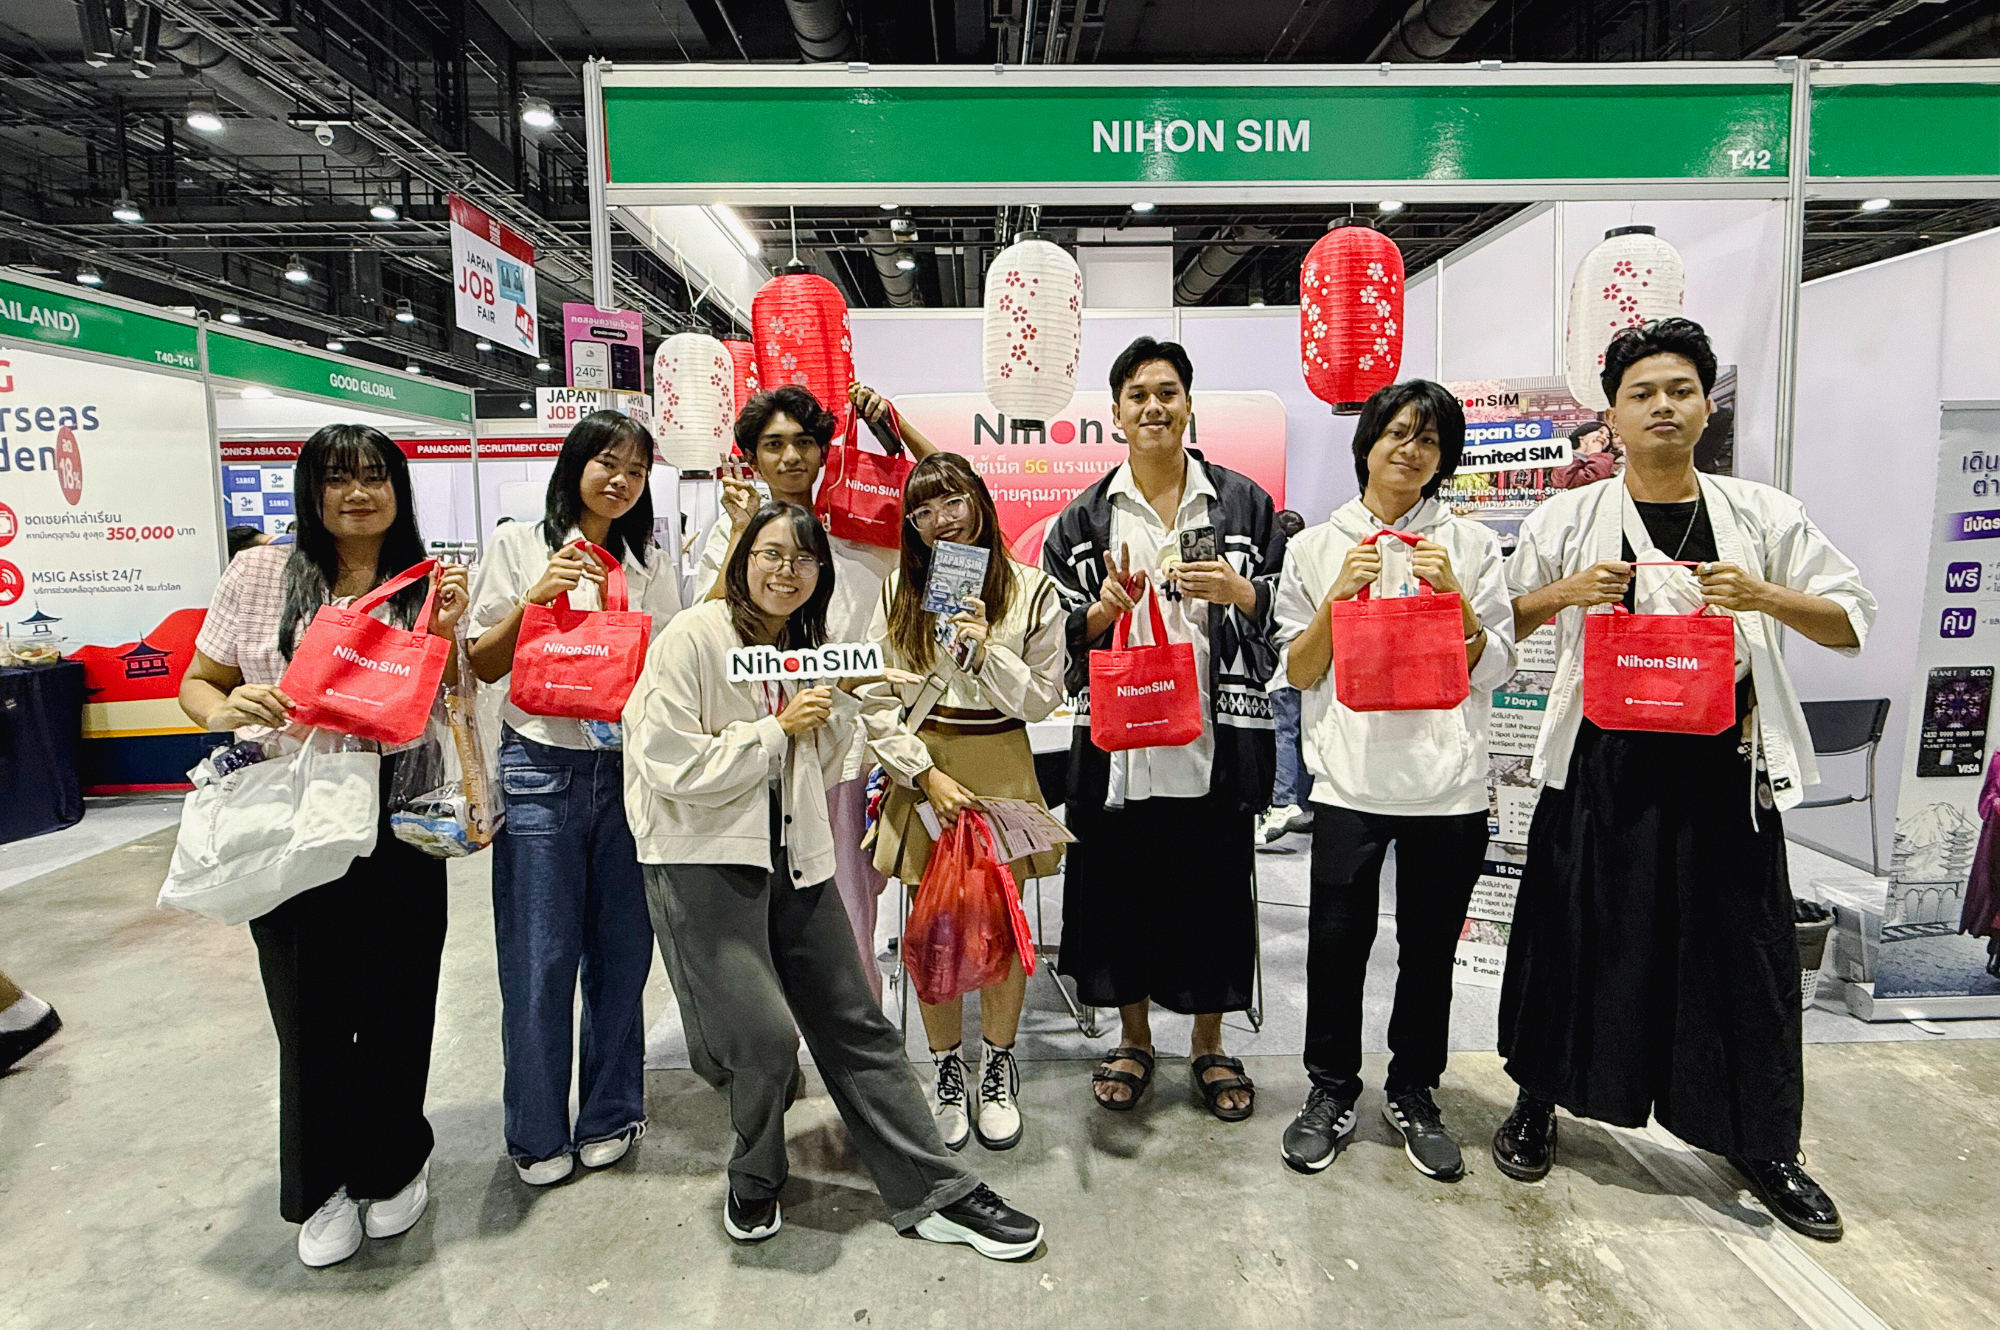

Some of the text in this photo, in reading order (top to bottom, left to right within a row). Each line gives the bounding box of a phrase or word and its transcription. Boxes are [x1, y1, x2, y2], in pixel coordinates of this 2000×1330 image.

[1093, 119, 1311, 153] NIHON SIM
[1728, 149, 1771, 170] T42
[466, 251, 493, 274] JAPAN
[459, 266, 495, 306] JOB
[477, 306, 496, 324] FAIR
[154, 350, 195, 368] T40-T41
[575, 366, 596, 378] 240
[329, 373, 397, 400] GOOD GLOBAL
[547, 389, 597, 403] JAPAN
[547, 405, 577, 420] JOB
[1514, 423, 1541, 438] 5G
[253, 446, 275, 455] ASIA
[417, 444, 471, 454] PANASONIC
[1529, 445, 1563, 461] SIM
[59, 457, 81, 490] 18%
[1024, 459, 1048, 474] 5G
[25, 511, 122, 525] ชดเชยค่าเล่าเรียน
[106, 526, 175, 542] 350,000
[177, 526, 196, 536] บาท
[31, 568, 142, 583] MSIG Assist 24/7
[1949, 567, 1979, 588] ฟรี
[134, 584, 144, 592] 24
[1943, 610, 1973, 636] คุ้ม
[1970, 669, 1985, 677] SCB
[1504, 696, 1538, 708] 7 Days
[1957, 764, 1980, 773] VISA
[1496, 865, 1506, 874] 15
[1473, 956, 1487, 964] Tel:
[1473, 967, 1501, 976] E-mail:
